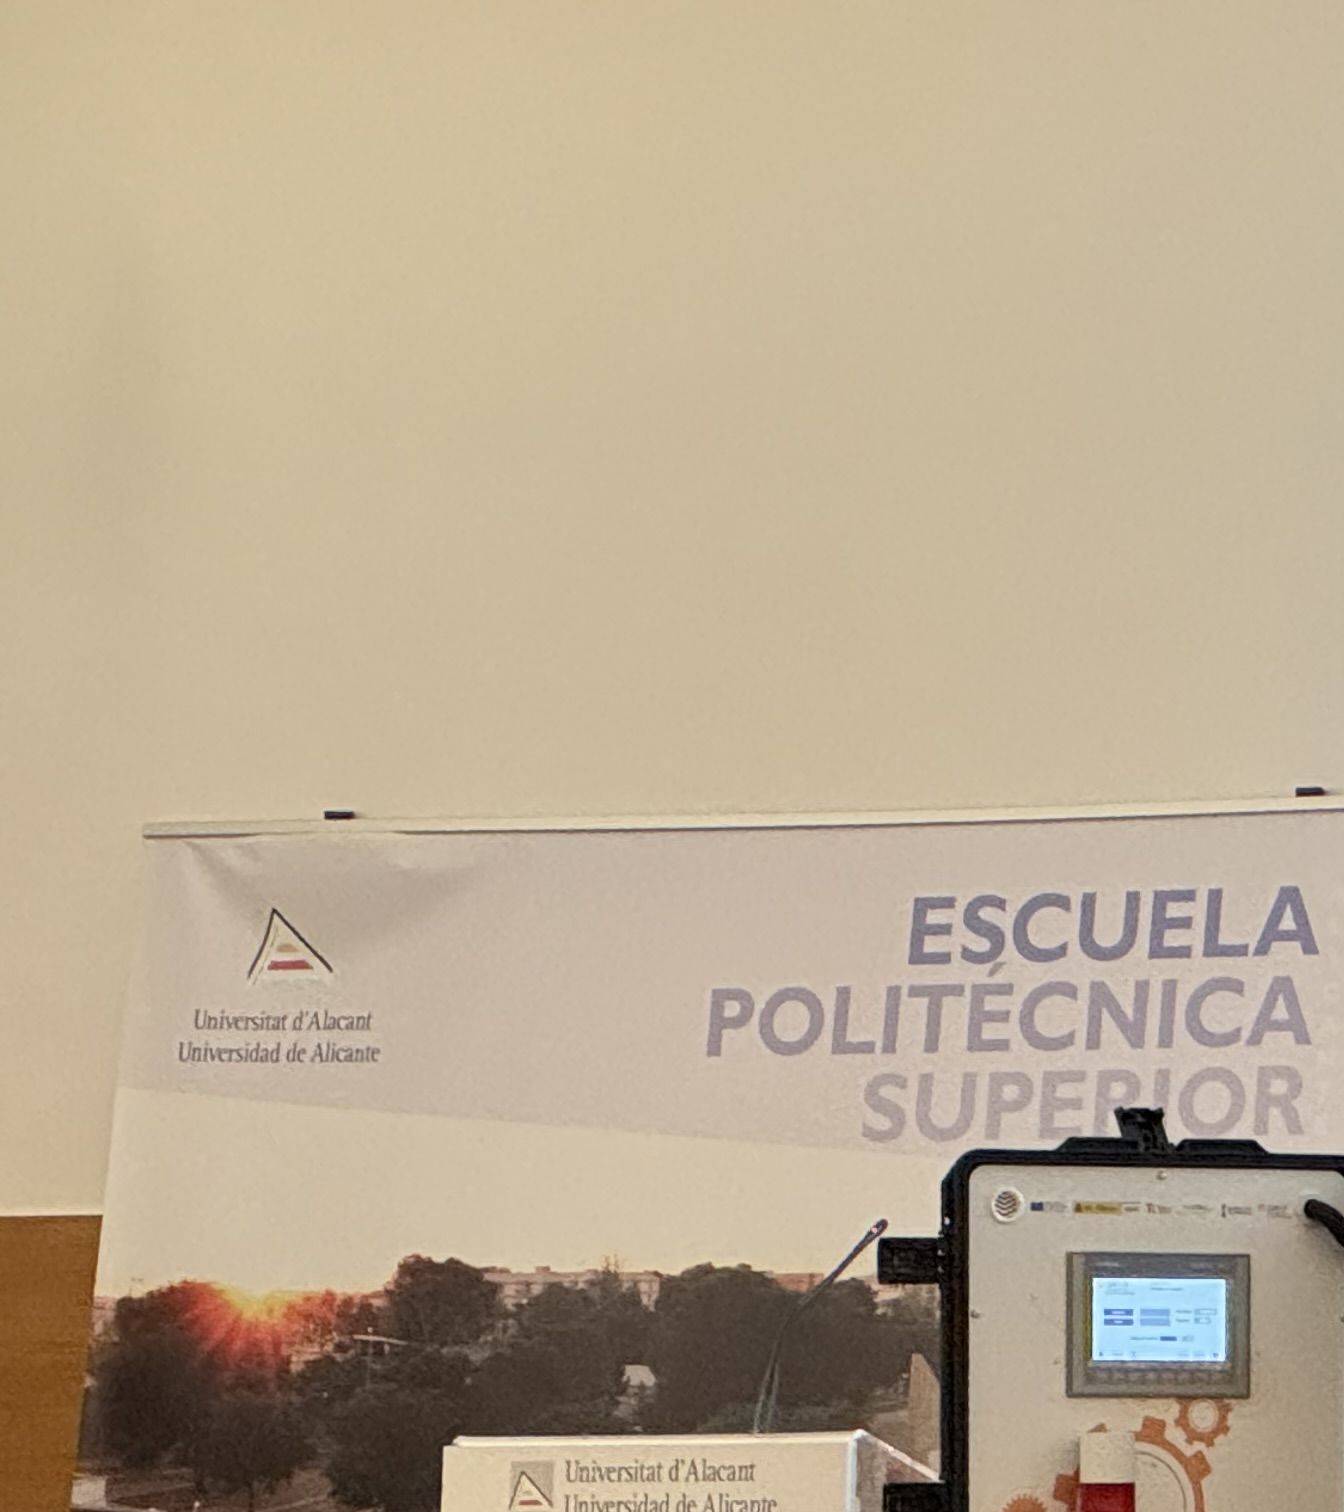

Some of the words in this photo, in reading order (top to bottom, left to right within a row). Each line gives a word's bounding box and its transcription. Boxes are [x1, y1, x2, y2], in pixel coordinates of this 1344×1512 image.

[908, 885, 1319, 965] ESCUELA
[193, 1008, 288, 1031] Universitat
[291, 1010, 373, 1031] d'Alacant
[706, 961, 1313, 1058] POLITÉCNICA
[178, 1041, 281, 1064] Universidad
[286, 1042, 307, 1063] de
[310, 1041, 381, 1063] Alicante
[861, 1065, 1306, 1143] SUPERIOR
[564, 1459, 665, 1483] Universitat
[668, 1459, 756, 1483] d'Alacant
